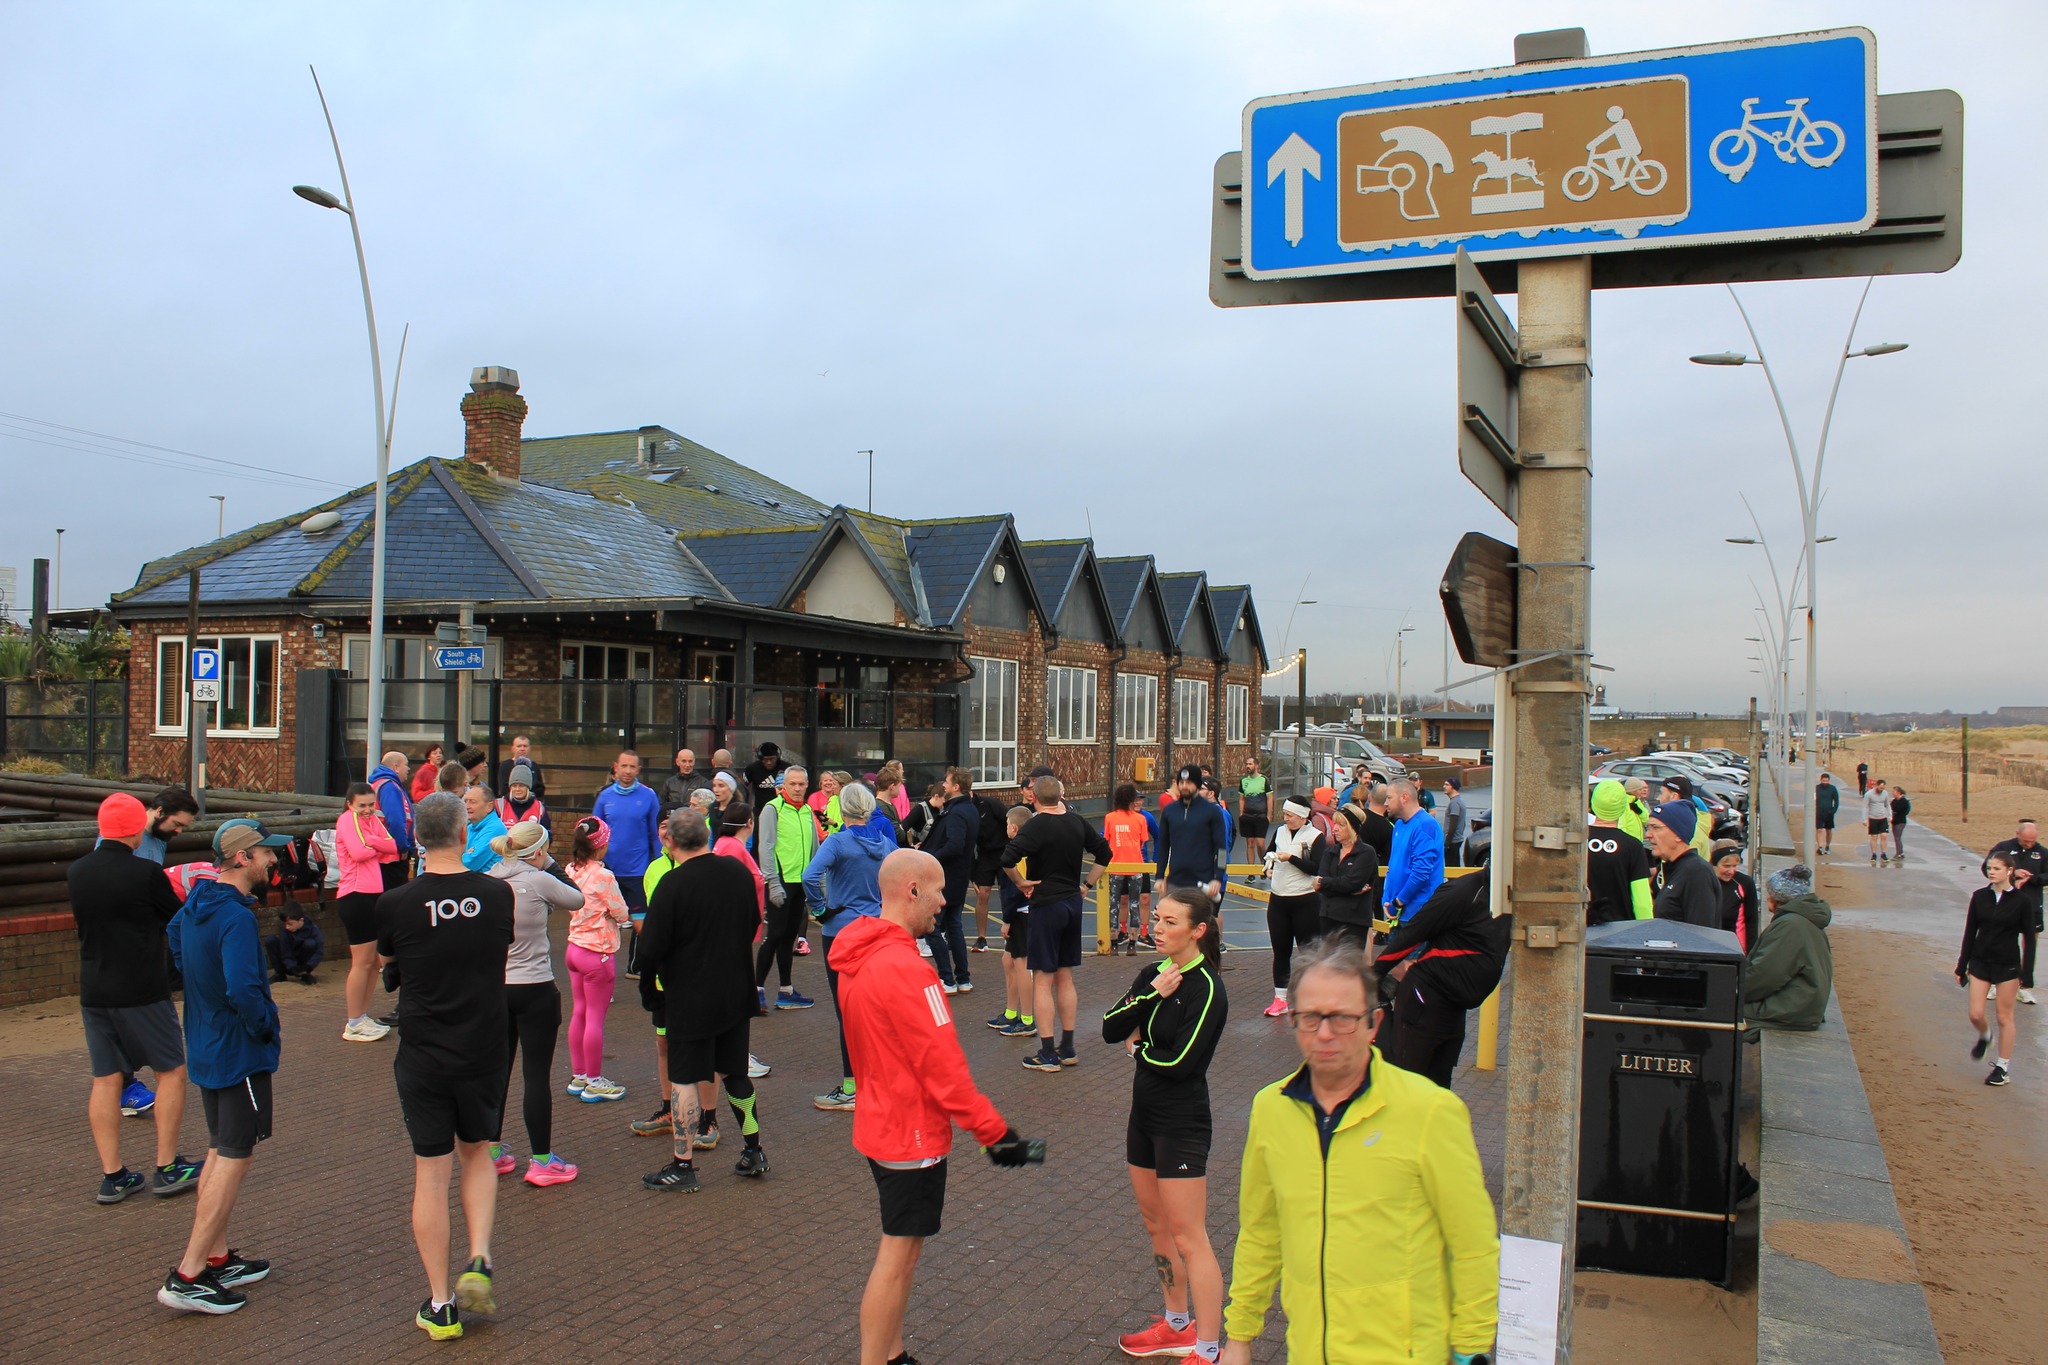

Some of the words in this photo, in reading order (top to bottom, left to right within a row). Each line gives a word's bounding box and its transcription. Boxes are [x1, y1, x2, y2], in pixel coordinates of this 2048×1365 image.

[444, 658, 466, 666] Shields
[447, 650, 465, 658] South
[198, 653, 215, 677] P
[425, 897, 481, 927] 100
[1620, 1054, 1693, 1074] LITTER
